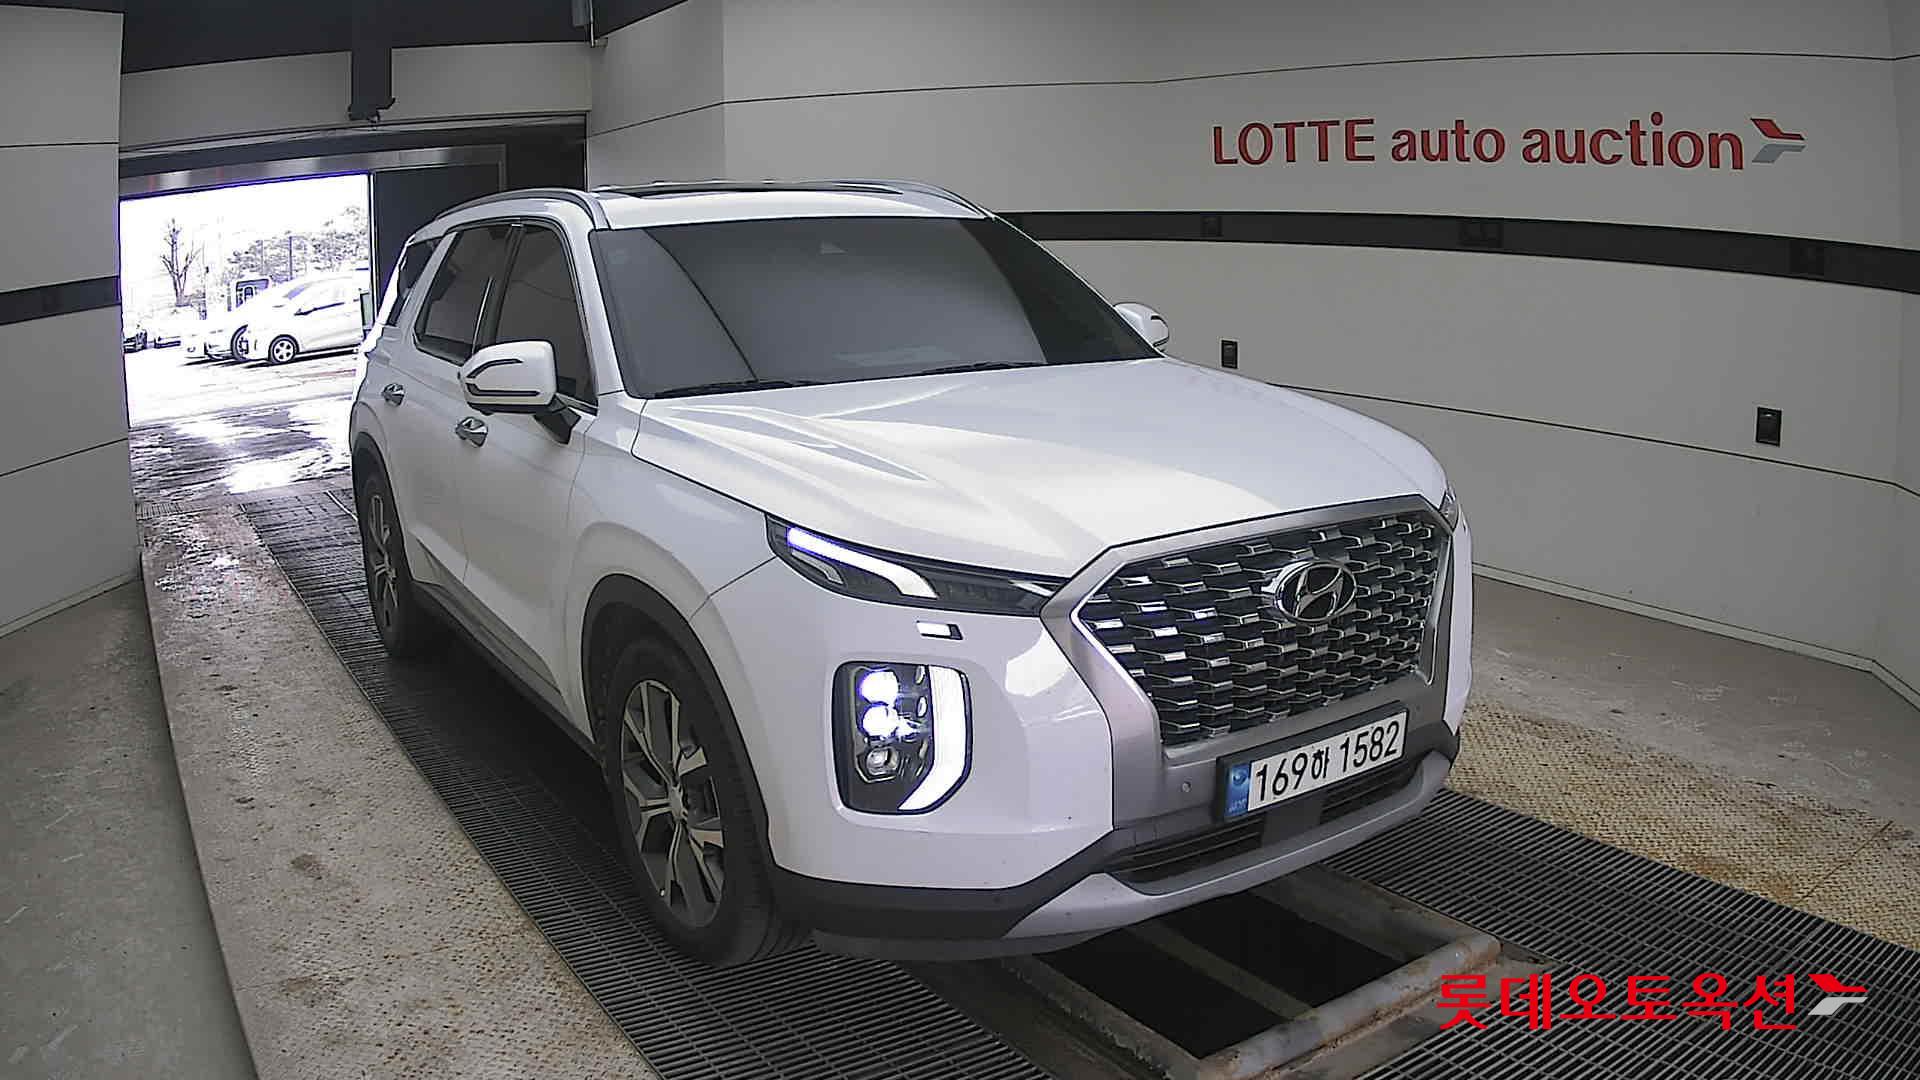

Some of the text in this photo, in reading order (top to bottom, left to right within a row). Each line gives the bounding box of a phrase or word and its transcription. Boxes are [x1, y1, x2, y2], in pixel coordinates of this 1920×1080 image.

[1213, 112, 1744, 170] LOTTE auto auction
[1256, 721, 1400, 801] 169하 1582
